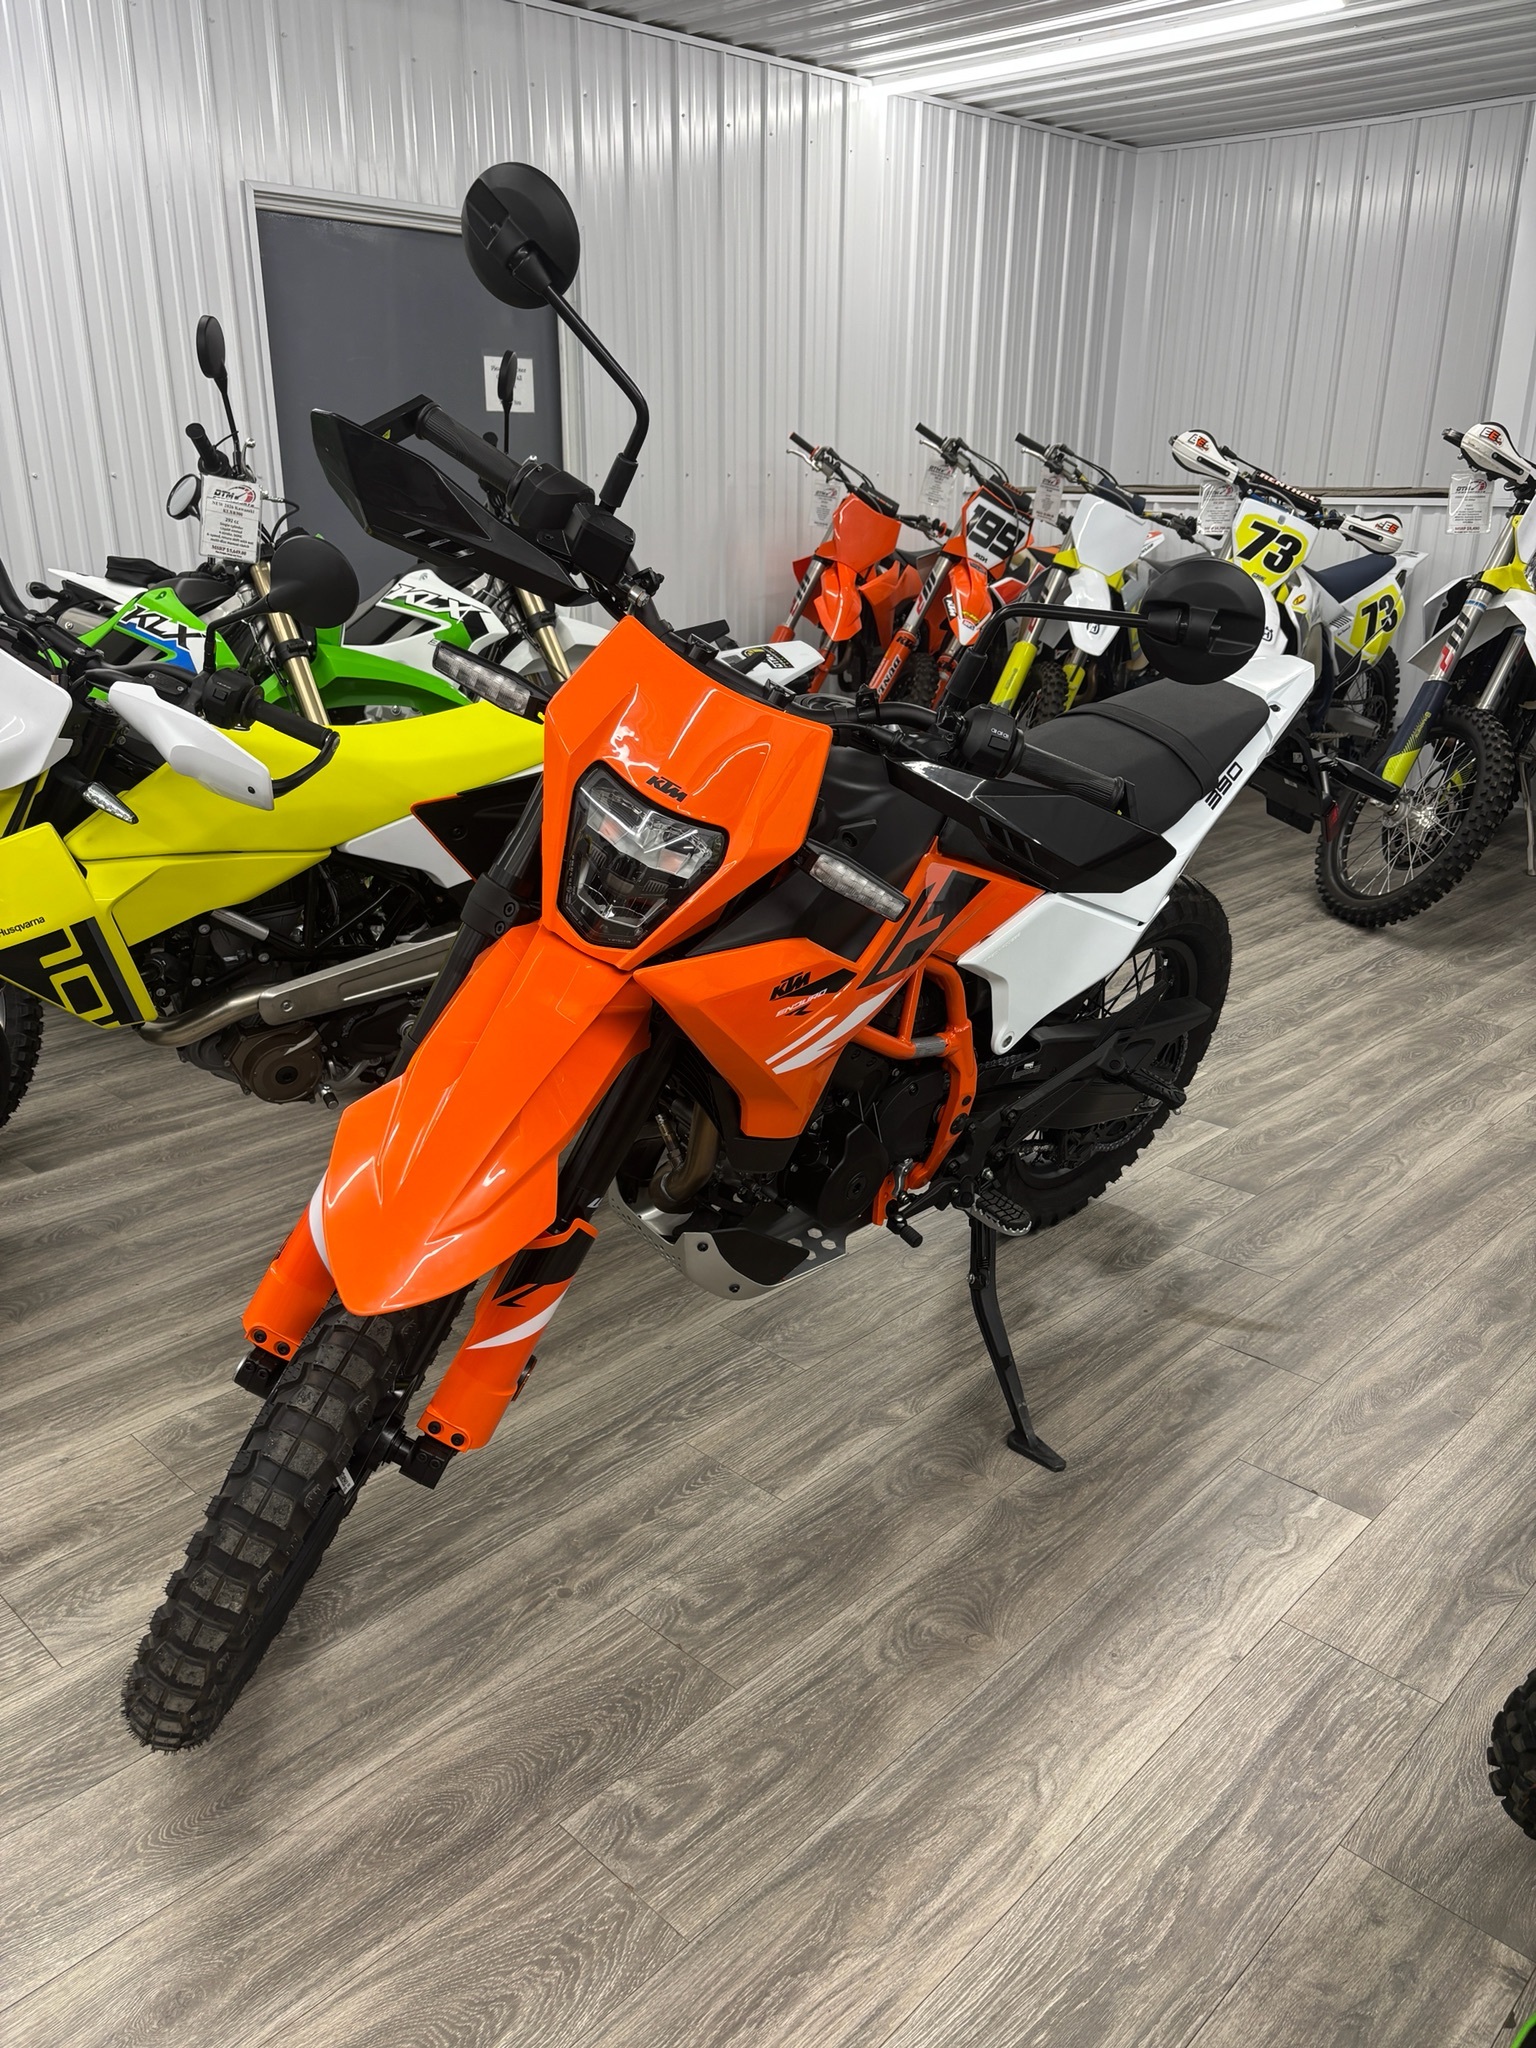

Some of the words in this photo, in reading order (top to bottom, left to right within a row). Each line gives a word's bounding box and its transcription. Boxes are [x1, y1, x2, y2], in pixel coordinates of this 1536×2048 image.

[214, 489, 235, 500] DTM
[1259, 472, 1318, 503] RENTHAL
[966, 504, 1026, 560] 199
[1237, 520, 1303, 574] 73
[385, 583, 491, 623] KLX
[1361, 594, 1398, 645] 73
[121, 605, 206, 651] KLX
[646, 775, 688, 803] KTM
[1204, 761, 1244, 811] 390
[0, 916, 46, 938] Husqvarna
[769, 971, 812, 1001] KTM
[775, 988, 828, 1018] ENDURO
